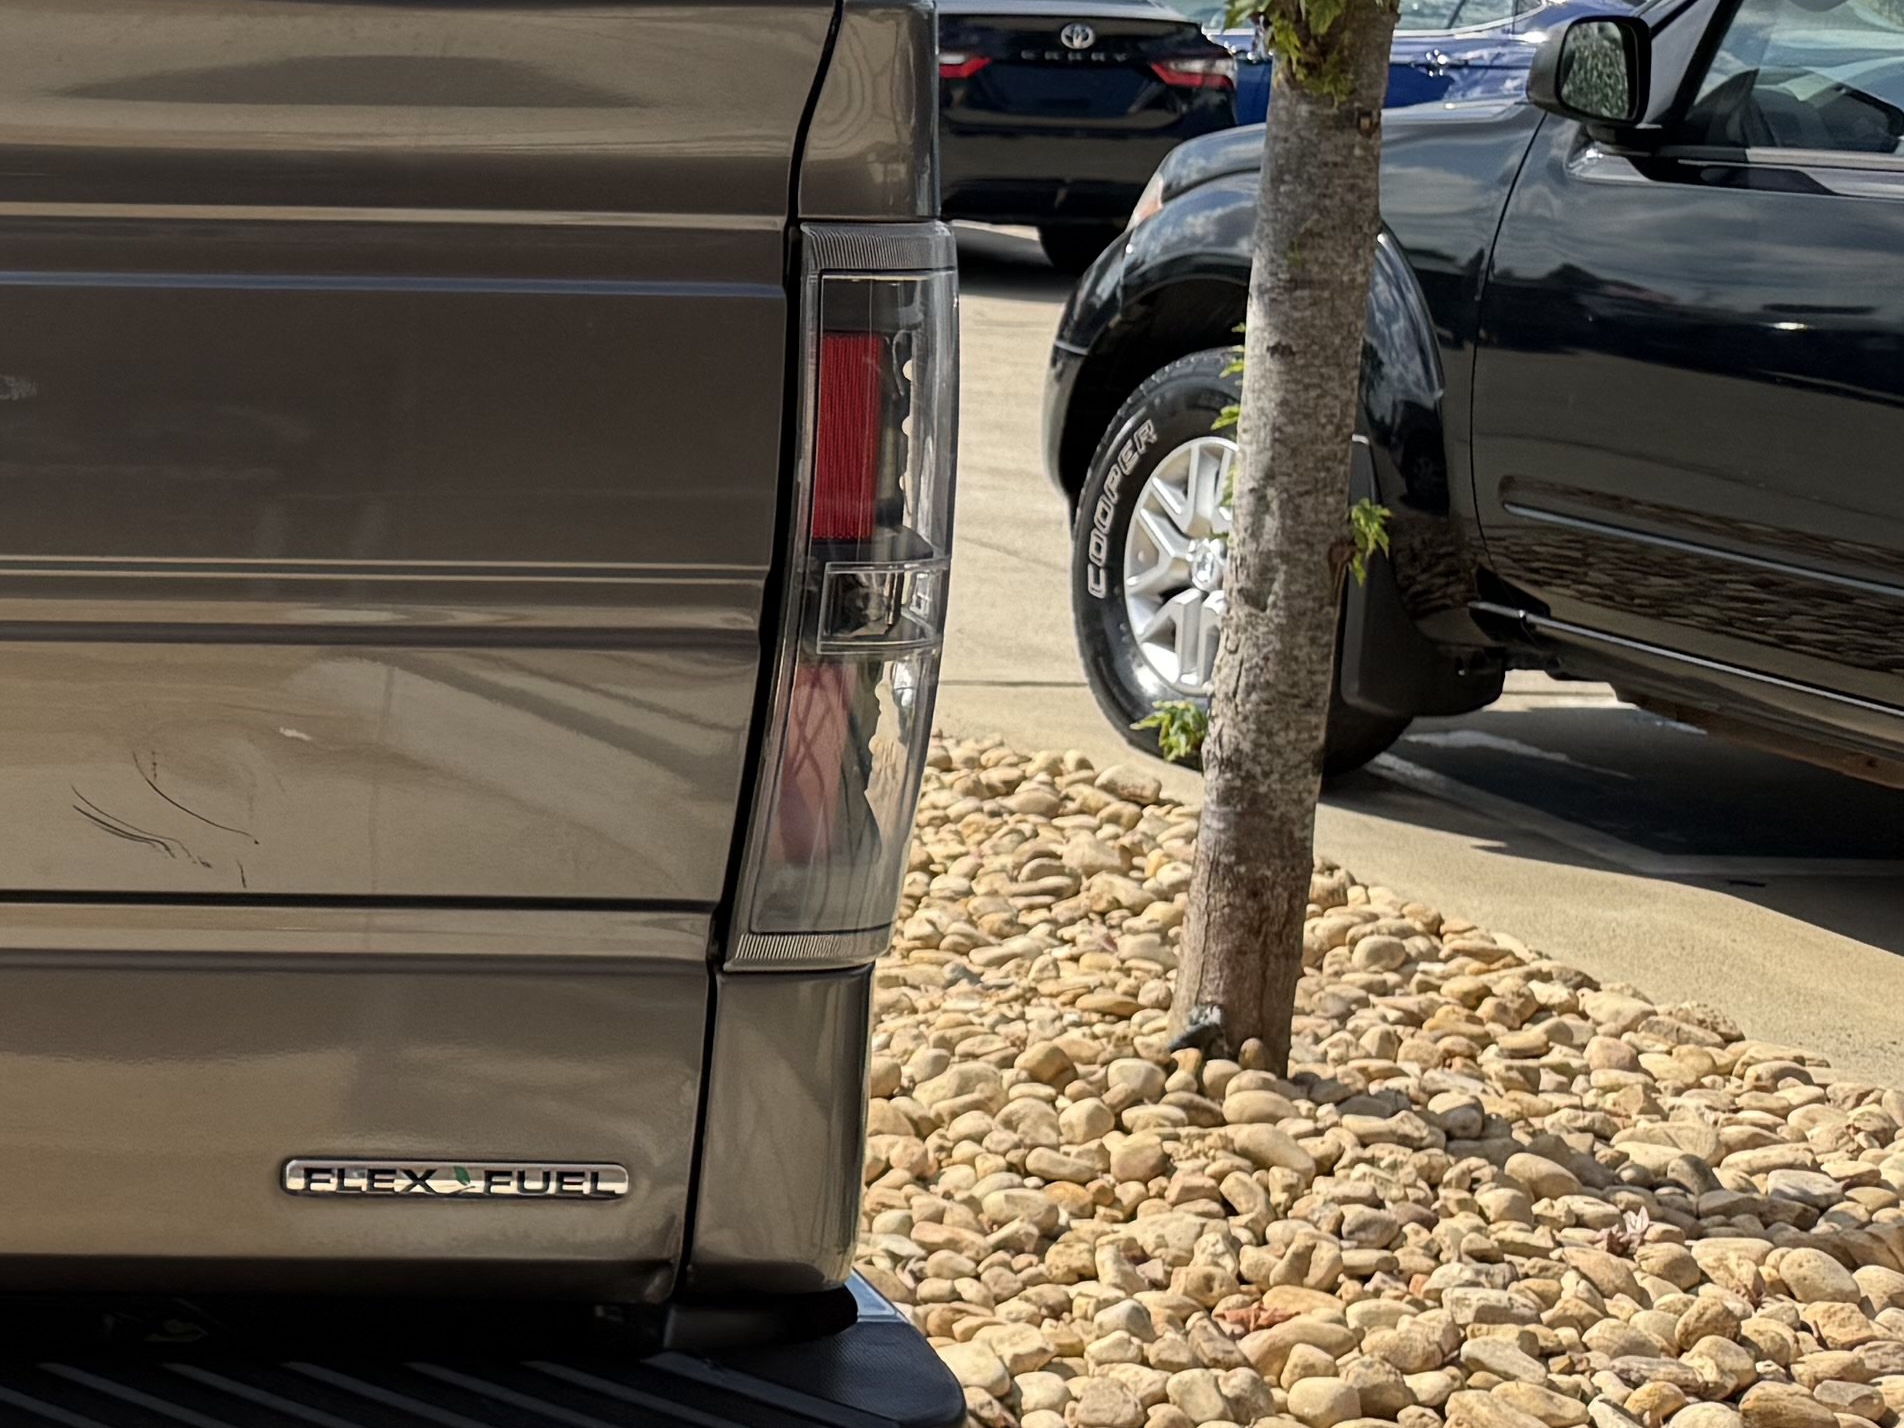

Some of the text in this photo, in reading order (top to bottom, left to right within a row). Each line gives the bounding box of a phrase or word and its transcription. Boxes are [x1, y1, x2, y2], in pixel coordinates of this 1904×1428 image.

[1086, 418, 1159, 599] COOPER
[302, 1166, 621, 1197] FLEX FUEL
